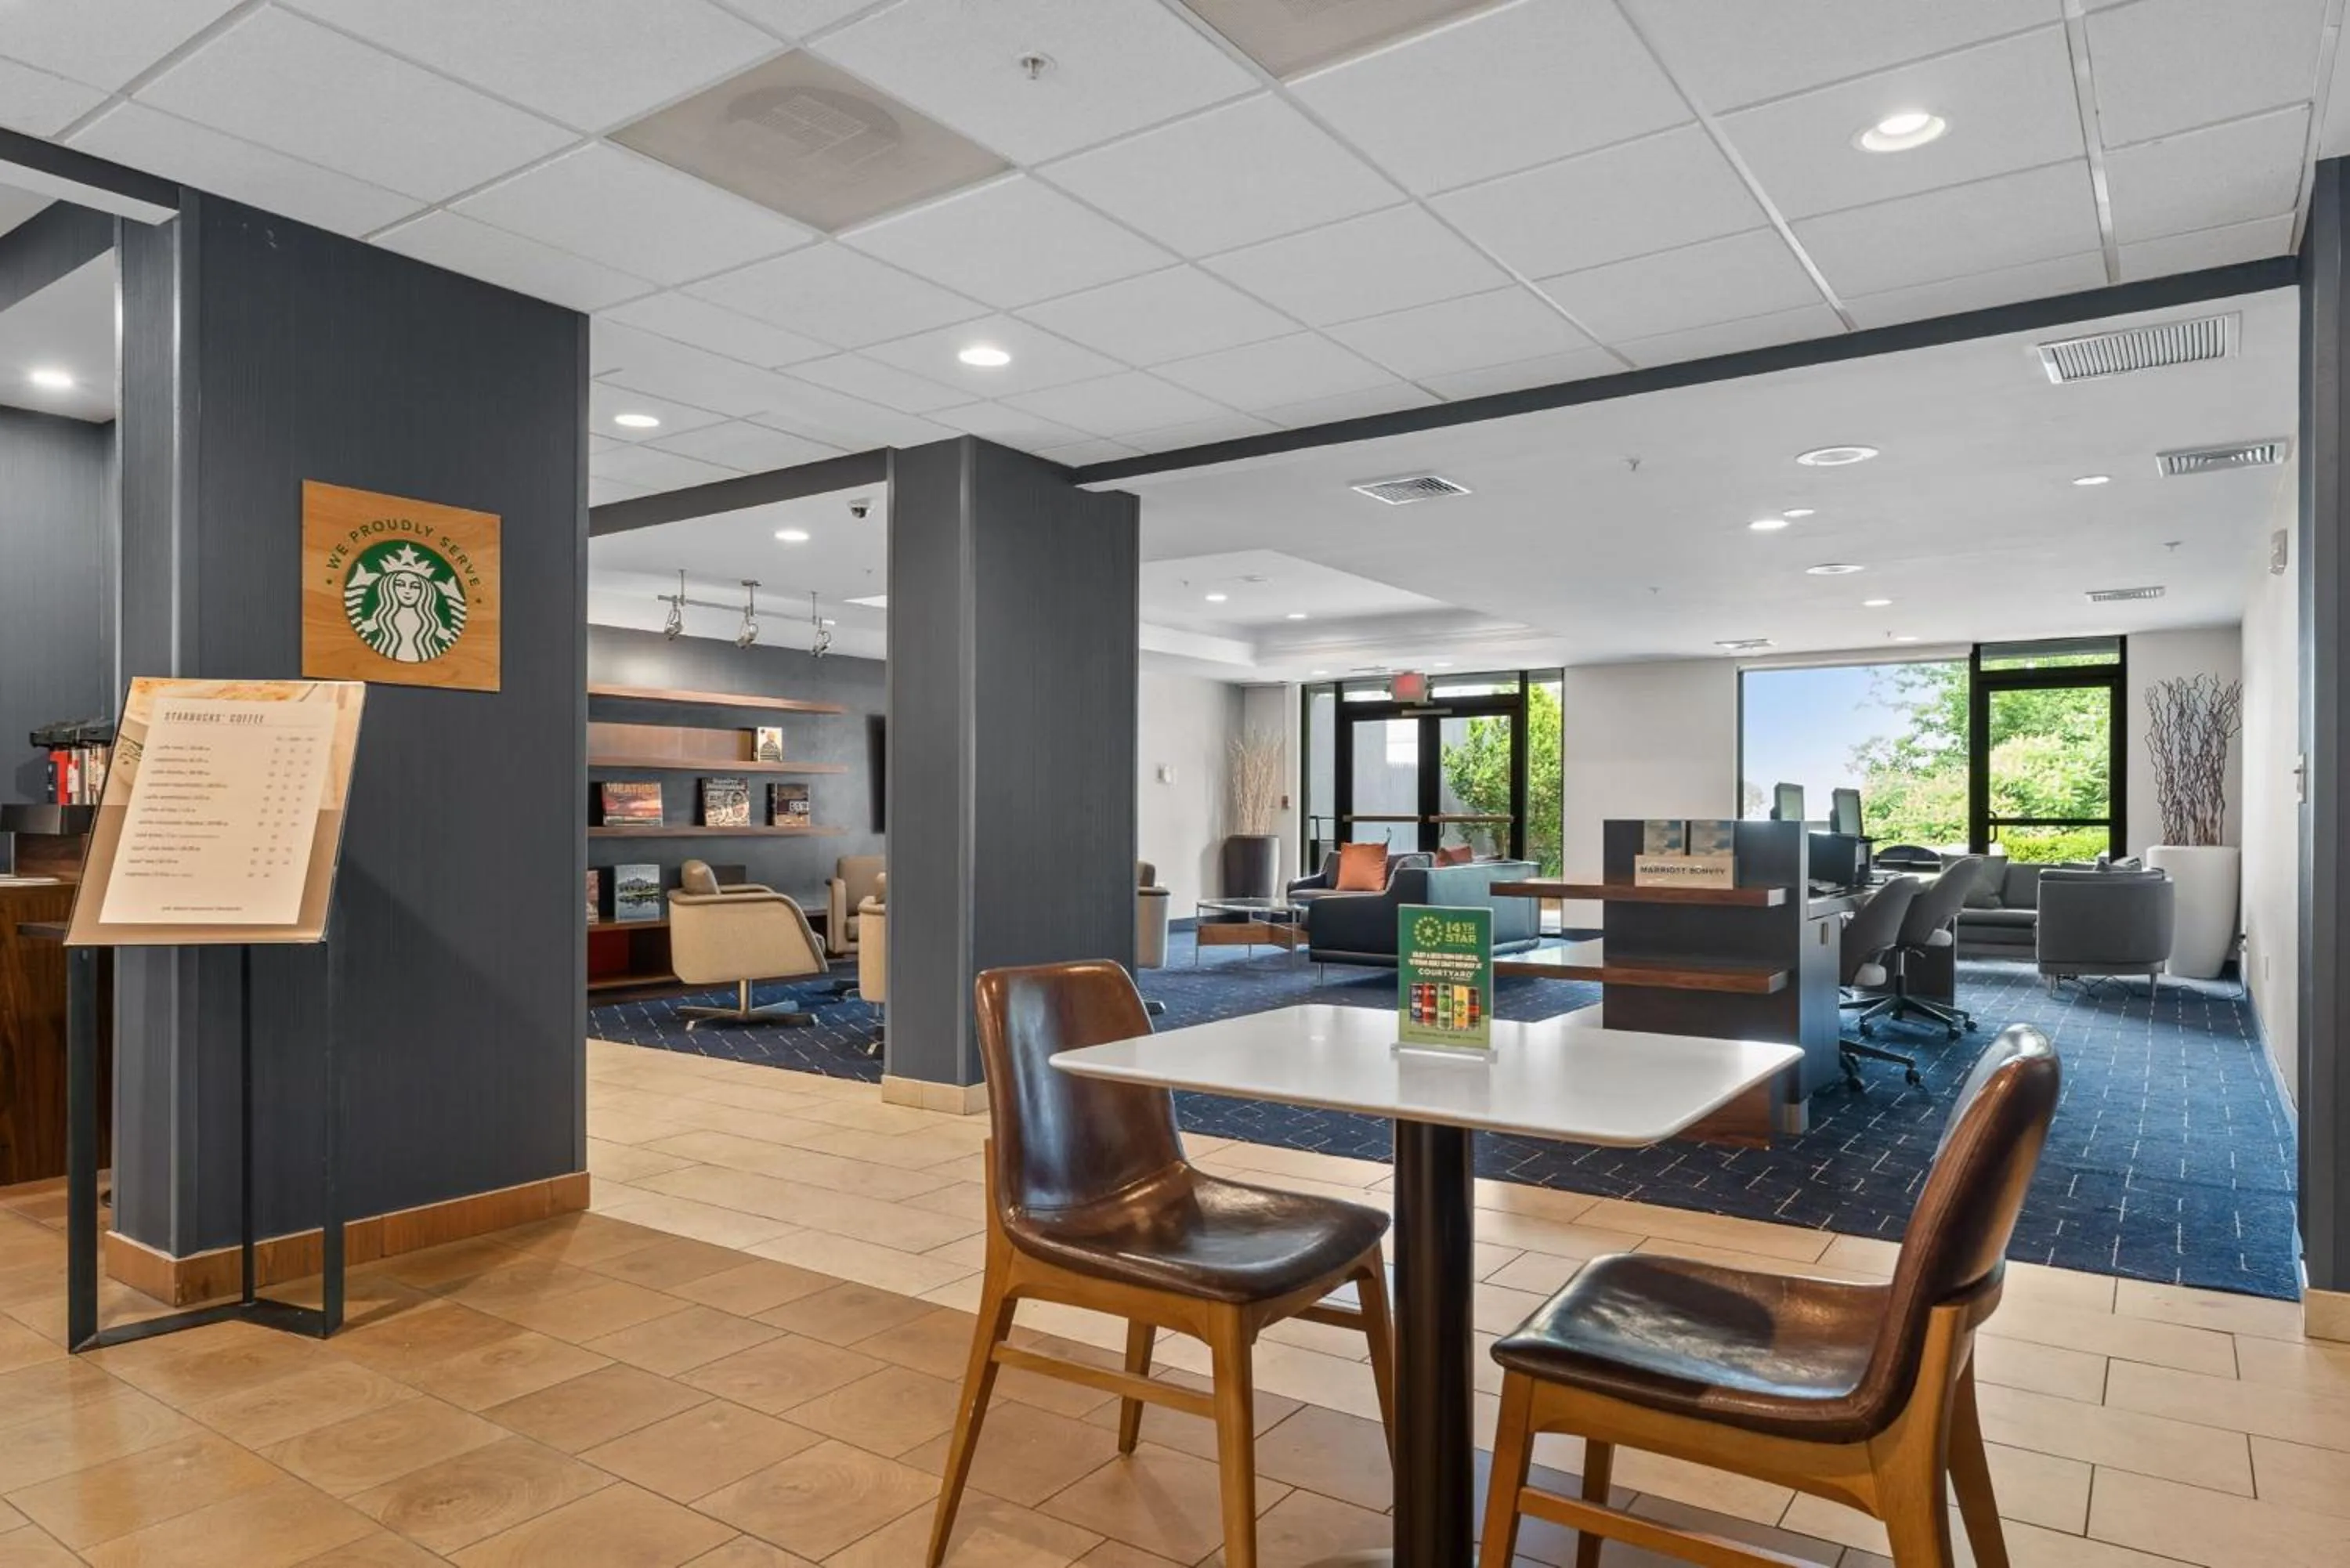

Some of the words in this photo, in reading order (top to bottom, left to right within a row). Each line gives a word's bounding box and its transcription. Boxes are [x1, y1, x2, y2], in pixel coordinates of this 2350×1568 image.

[325, 543, 349, 570] WE
[349, 518, 435, 543] PROUDLY
[439, 537, 481, 587] SERVE
[1640, 865, 1686, 876] MARRIOTT
[1444, 933, 1477, 945] STAR
[1417, 967, 1475, 978] COURTYARD
